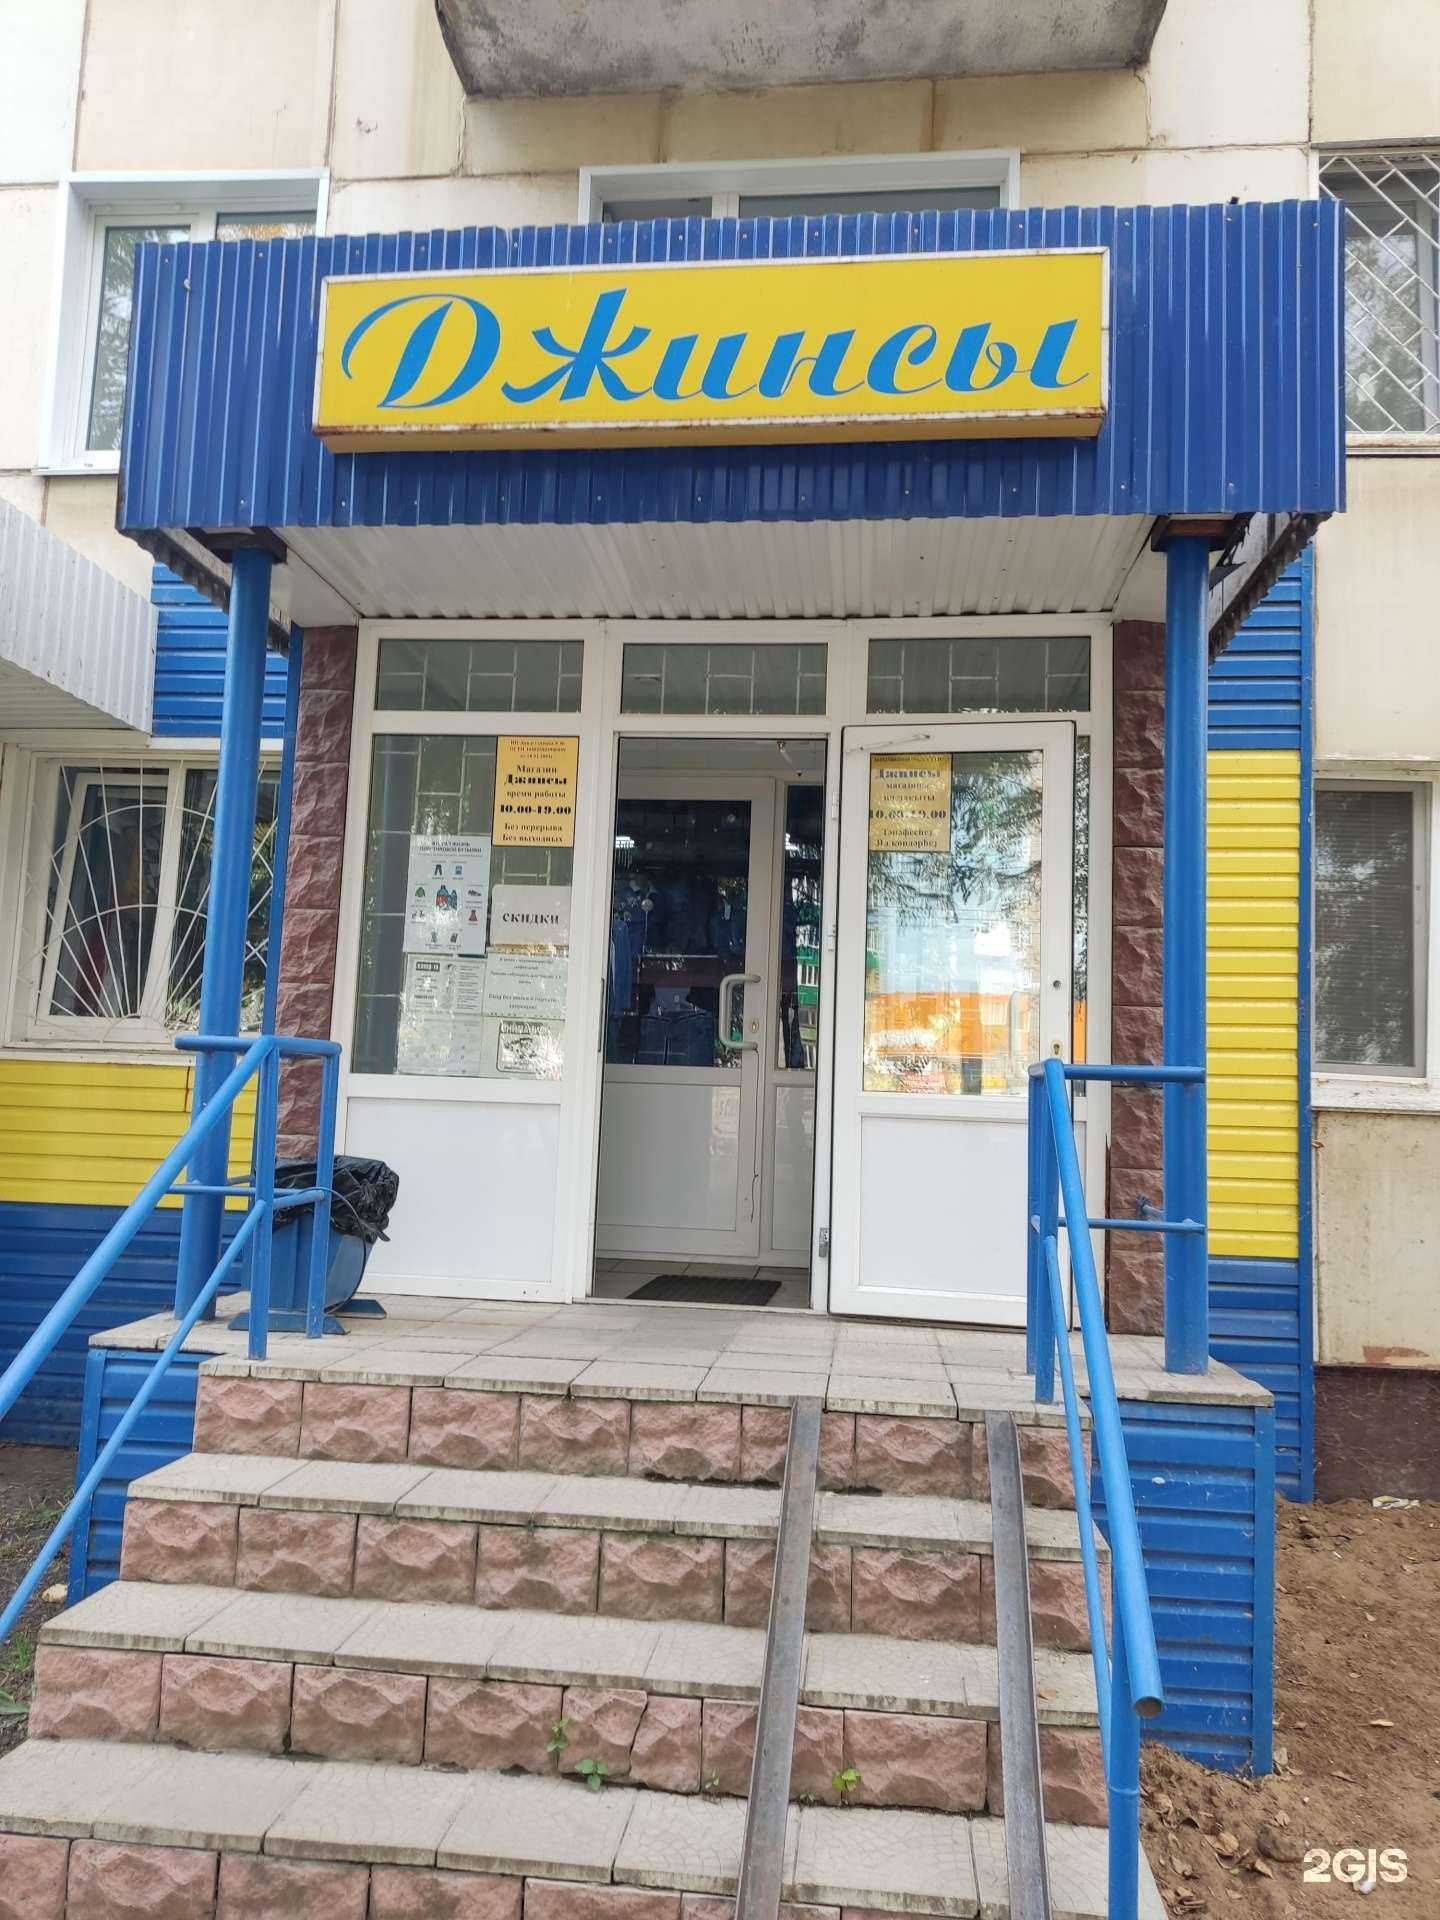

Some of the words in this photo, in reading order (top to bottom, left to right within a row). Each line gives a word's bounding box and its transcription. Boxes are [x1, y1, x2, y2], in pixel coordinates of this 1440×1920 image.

[341, 288, 1090, 409] Джинсы
[516, 764, 557, 773] Магазин
[504, 774, 567, 786] Джинсы
[500, 804, 571, 815] 10.00-19.00
